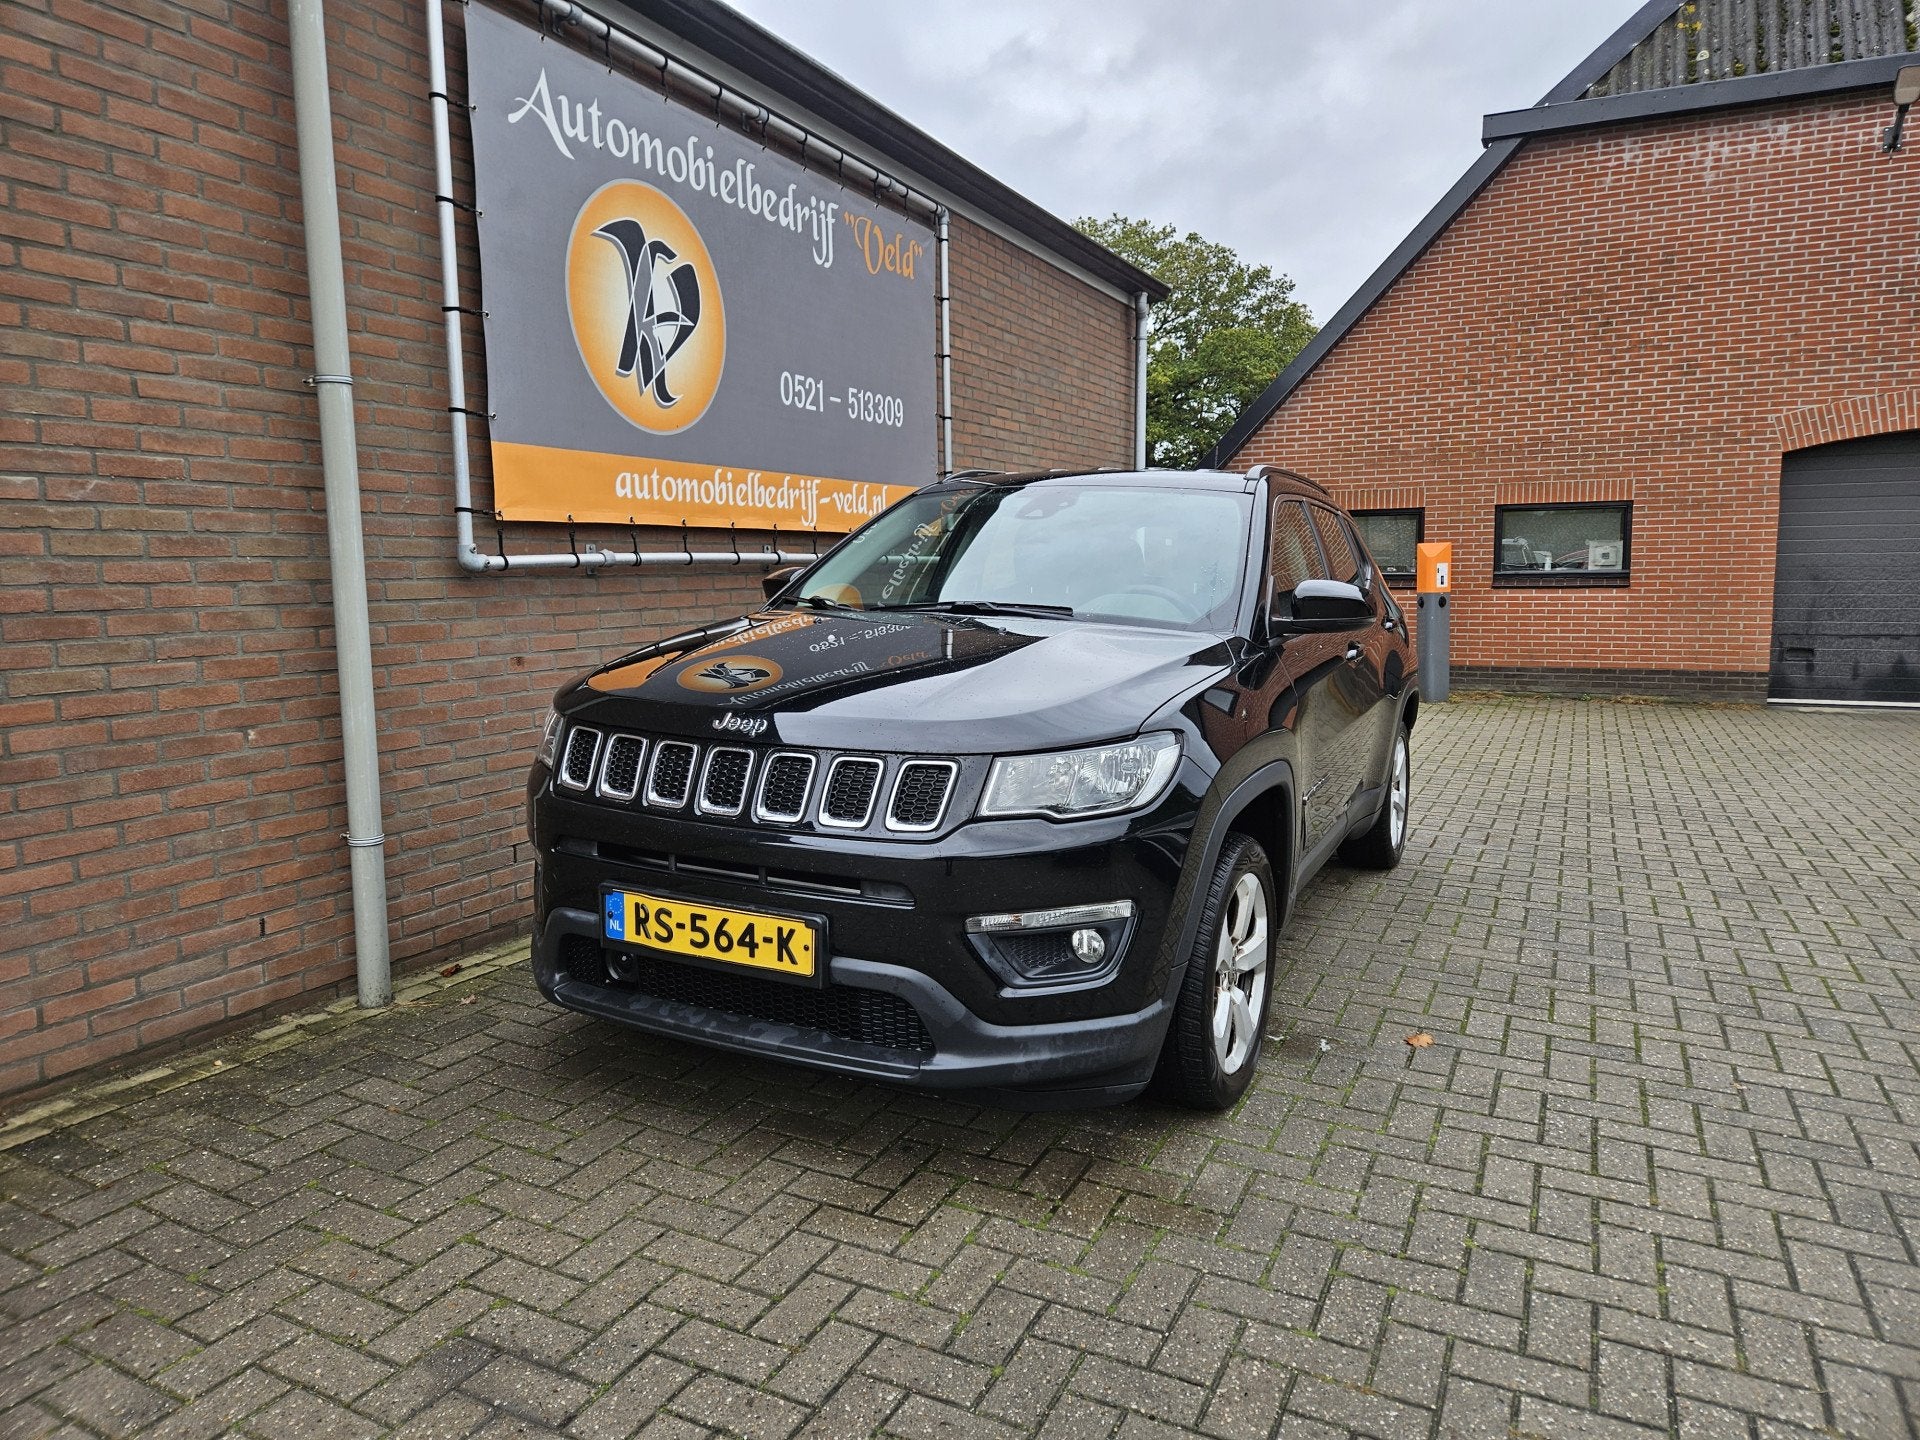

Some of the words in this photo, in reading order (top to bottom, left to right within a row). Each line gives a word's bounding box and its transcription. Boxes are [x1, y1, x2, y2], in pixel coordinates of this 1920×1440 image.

[508, 67, 839, 269] Automobielbedrijf
[780, 371, 824, 412] 0521
[848, 387, 904, 427] 513309
[615, 467, 888, 527] automobielbedrijf-veld.nl
[712, 712, 768, 738] Jeep
[609, 918, 623, 932] NL
[634, 901, 799, 966] RS-564-K
